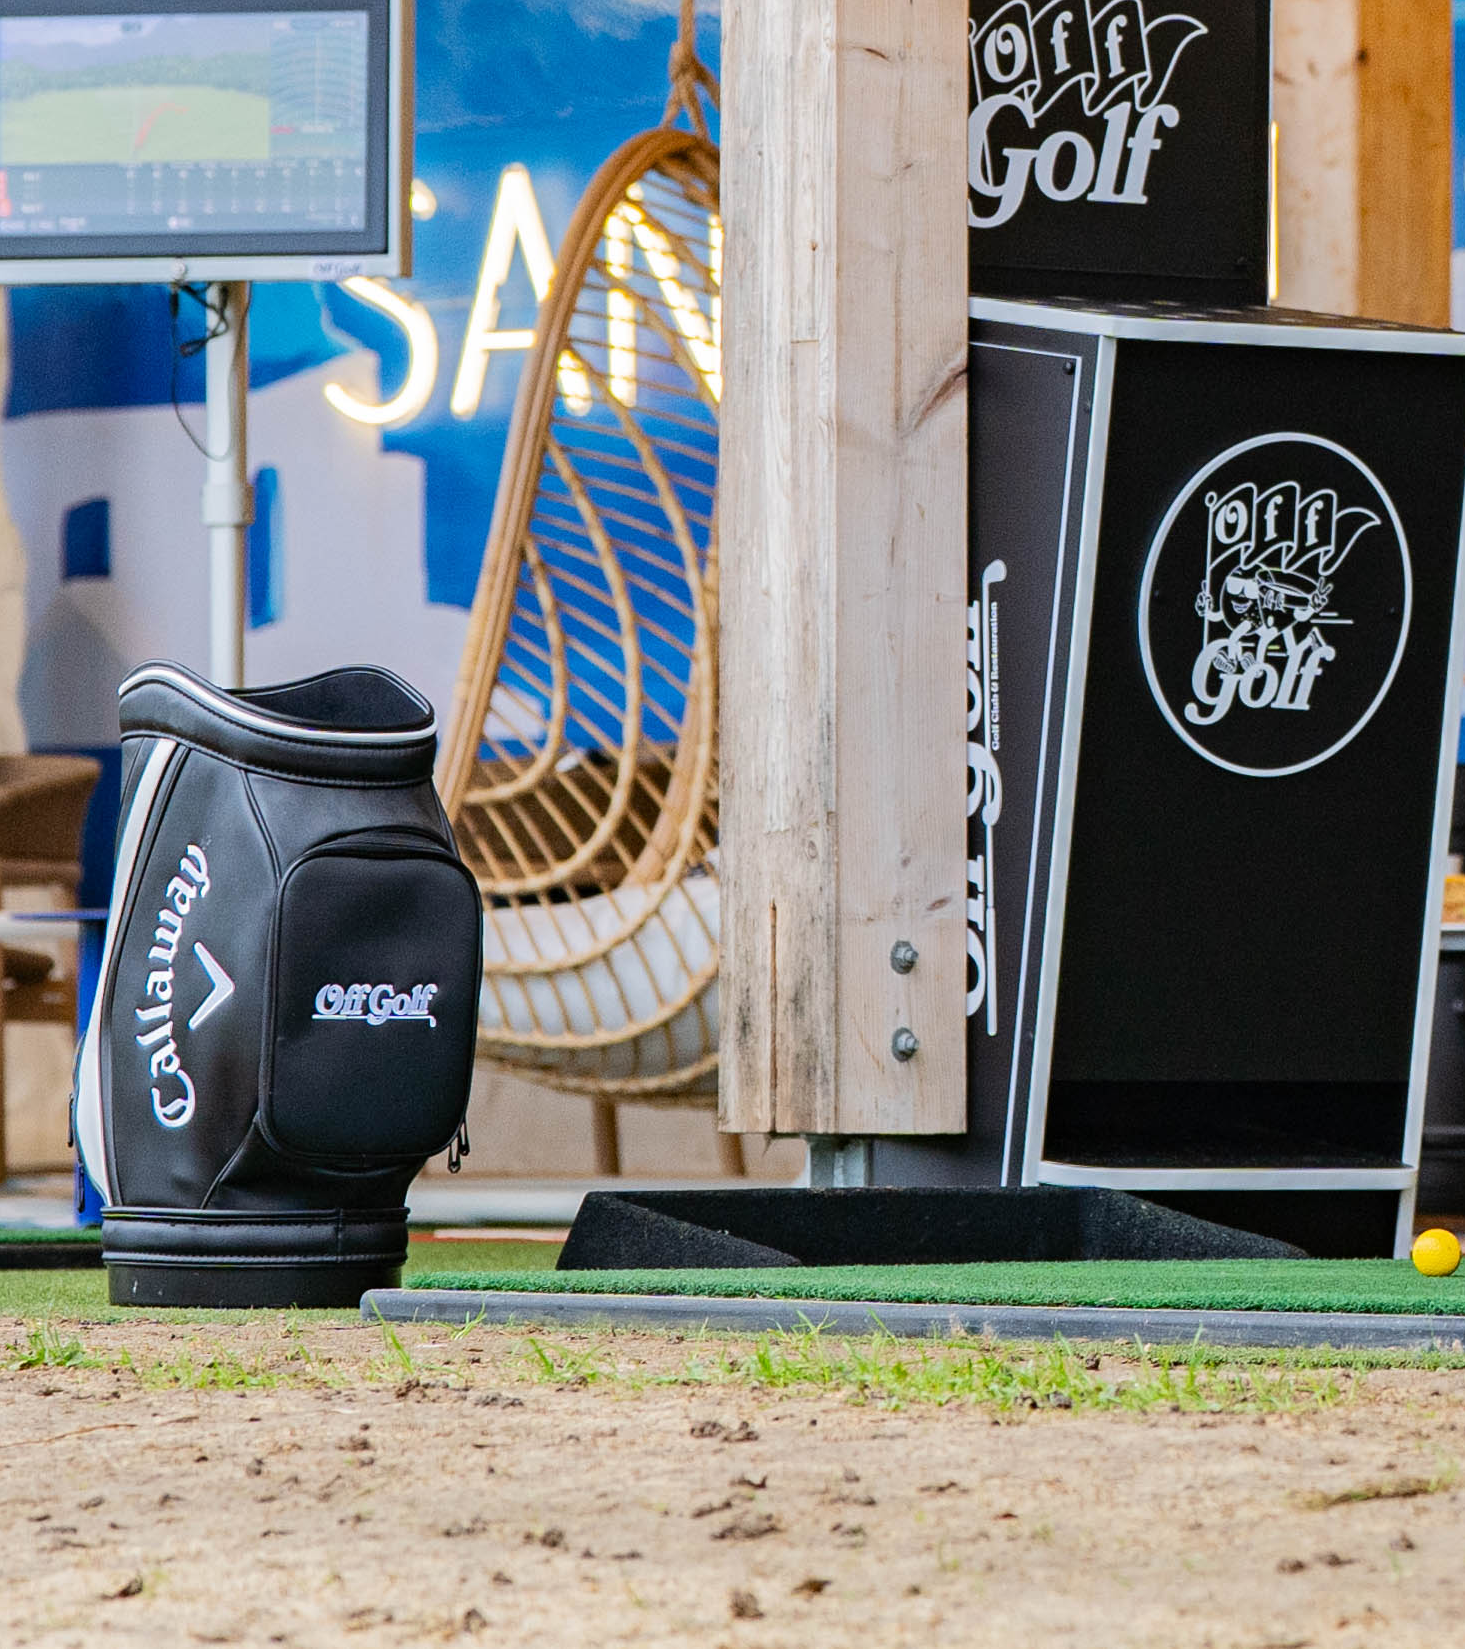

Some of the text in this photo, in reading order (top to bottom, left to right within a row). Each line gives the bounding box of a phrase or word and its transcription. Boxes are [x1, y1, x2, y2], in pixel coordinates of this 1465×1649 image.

[983, 11, 1129, 84] Off
[968, 93, 1180, 228] Golf
[1215, 494, 1324, 546] Off
[991, 694, 999, 723] Club
[135, 843, 210, 1129] Callaway
